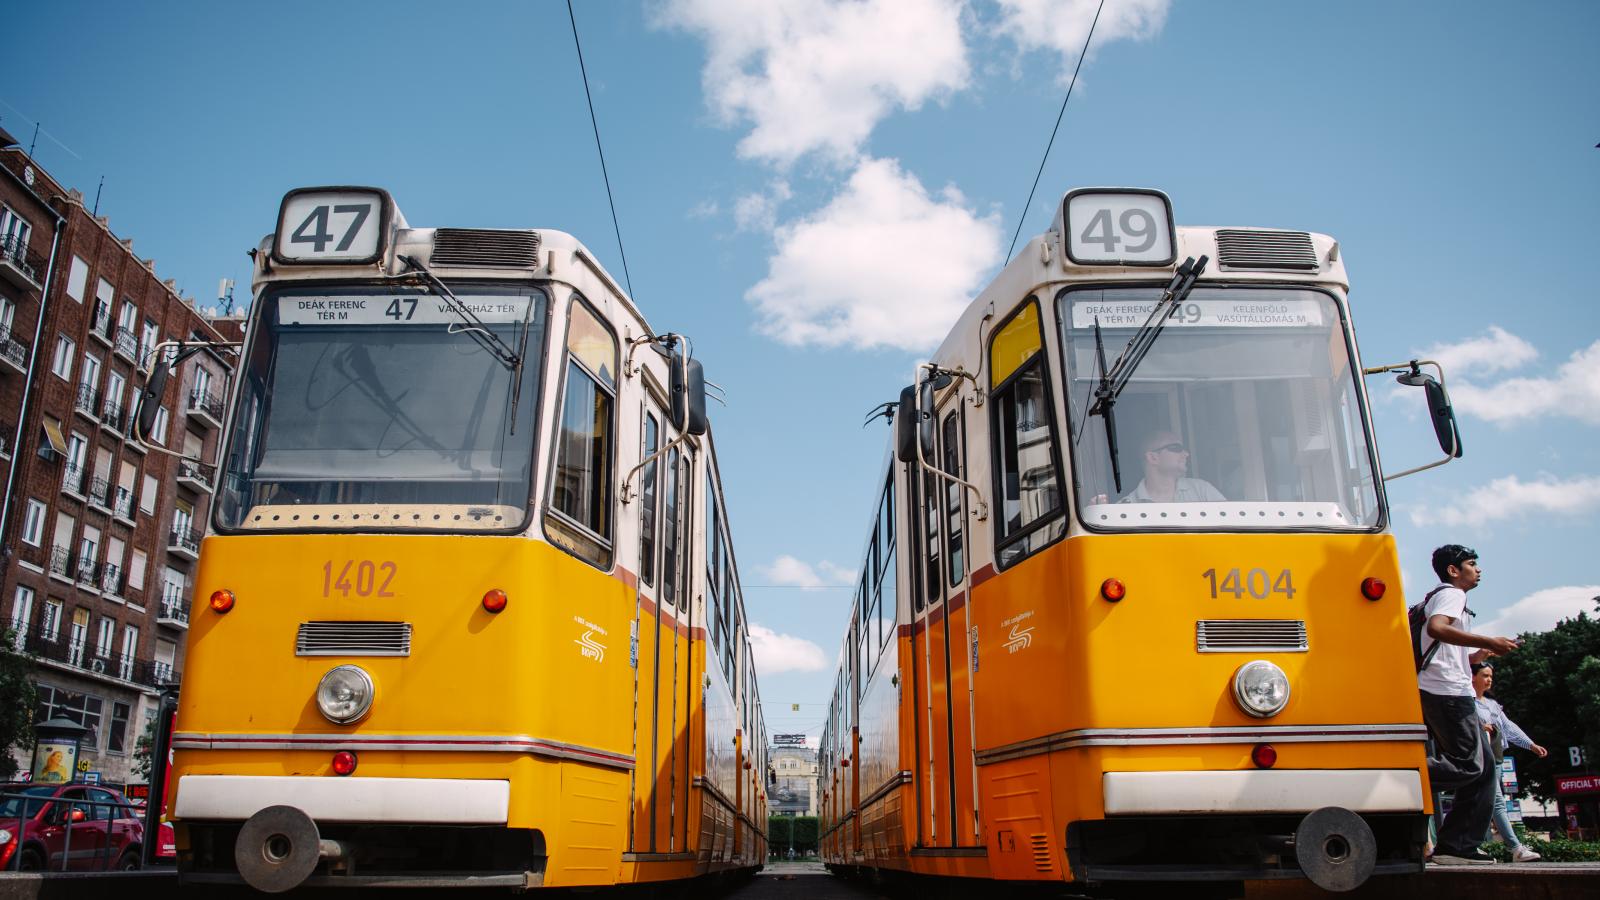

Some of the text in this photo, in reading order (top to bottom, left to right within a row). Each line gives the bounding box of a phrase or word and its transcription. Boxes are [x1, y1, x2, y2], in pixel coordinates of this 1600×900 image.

[290, 204, 371, 252] 47
[1080, 208, 1157, 253] 49
[298, 299, 366, 309] DEÁK FERENC
[385, 298, 418, 320] 47
[495, 302, 515, 313] TÉR
[1086, 303, 1152, 314] DEÁK FERENC
[1233, 304, 1288, 314] KELENFÖLD
[317, 309, 348, 320] TÉR M
[1104, 314, 1136, 323] TÉR M
[1168, 303, 1202, 324] 49
[1297, 314, 1306, 323] M
[323, 559, 397, 598] 1402
[1201, 567, 1297, 600] 1404
[1560, 779, 1593, 790] OFFICIAL
